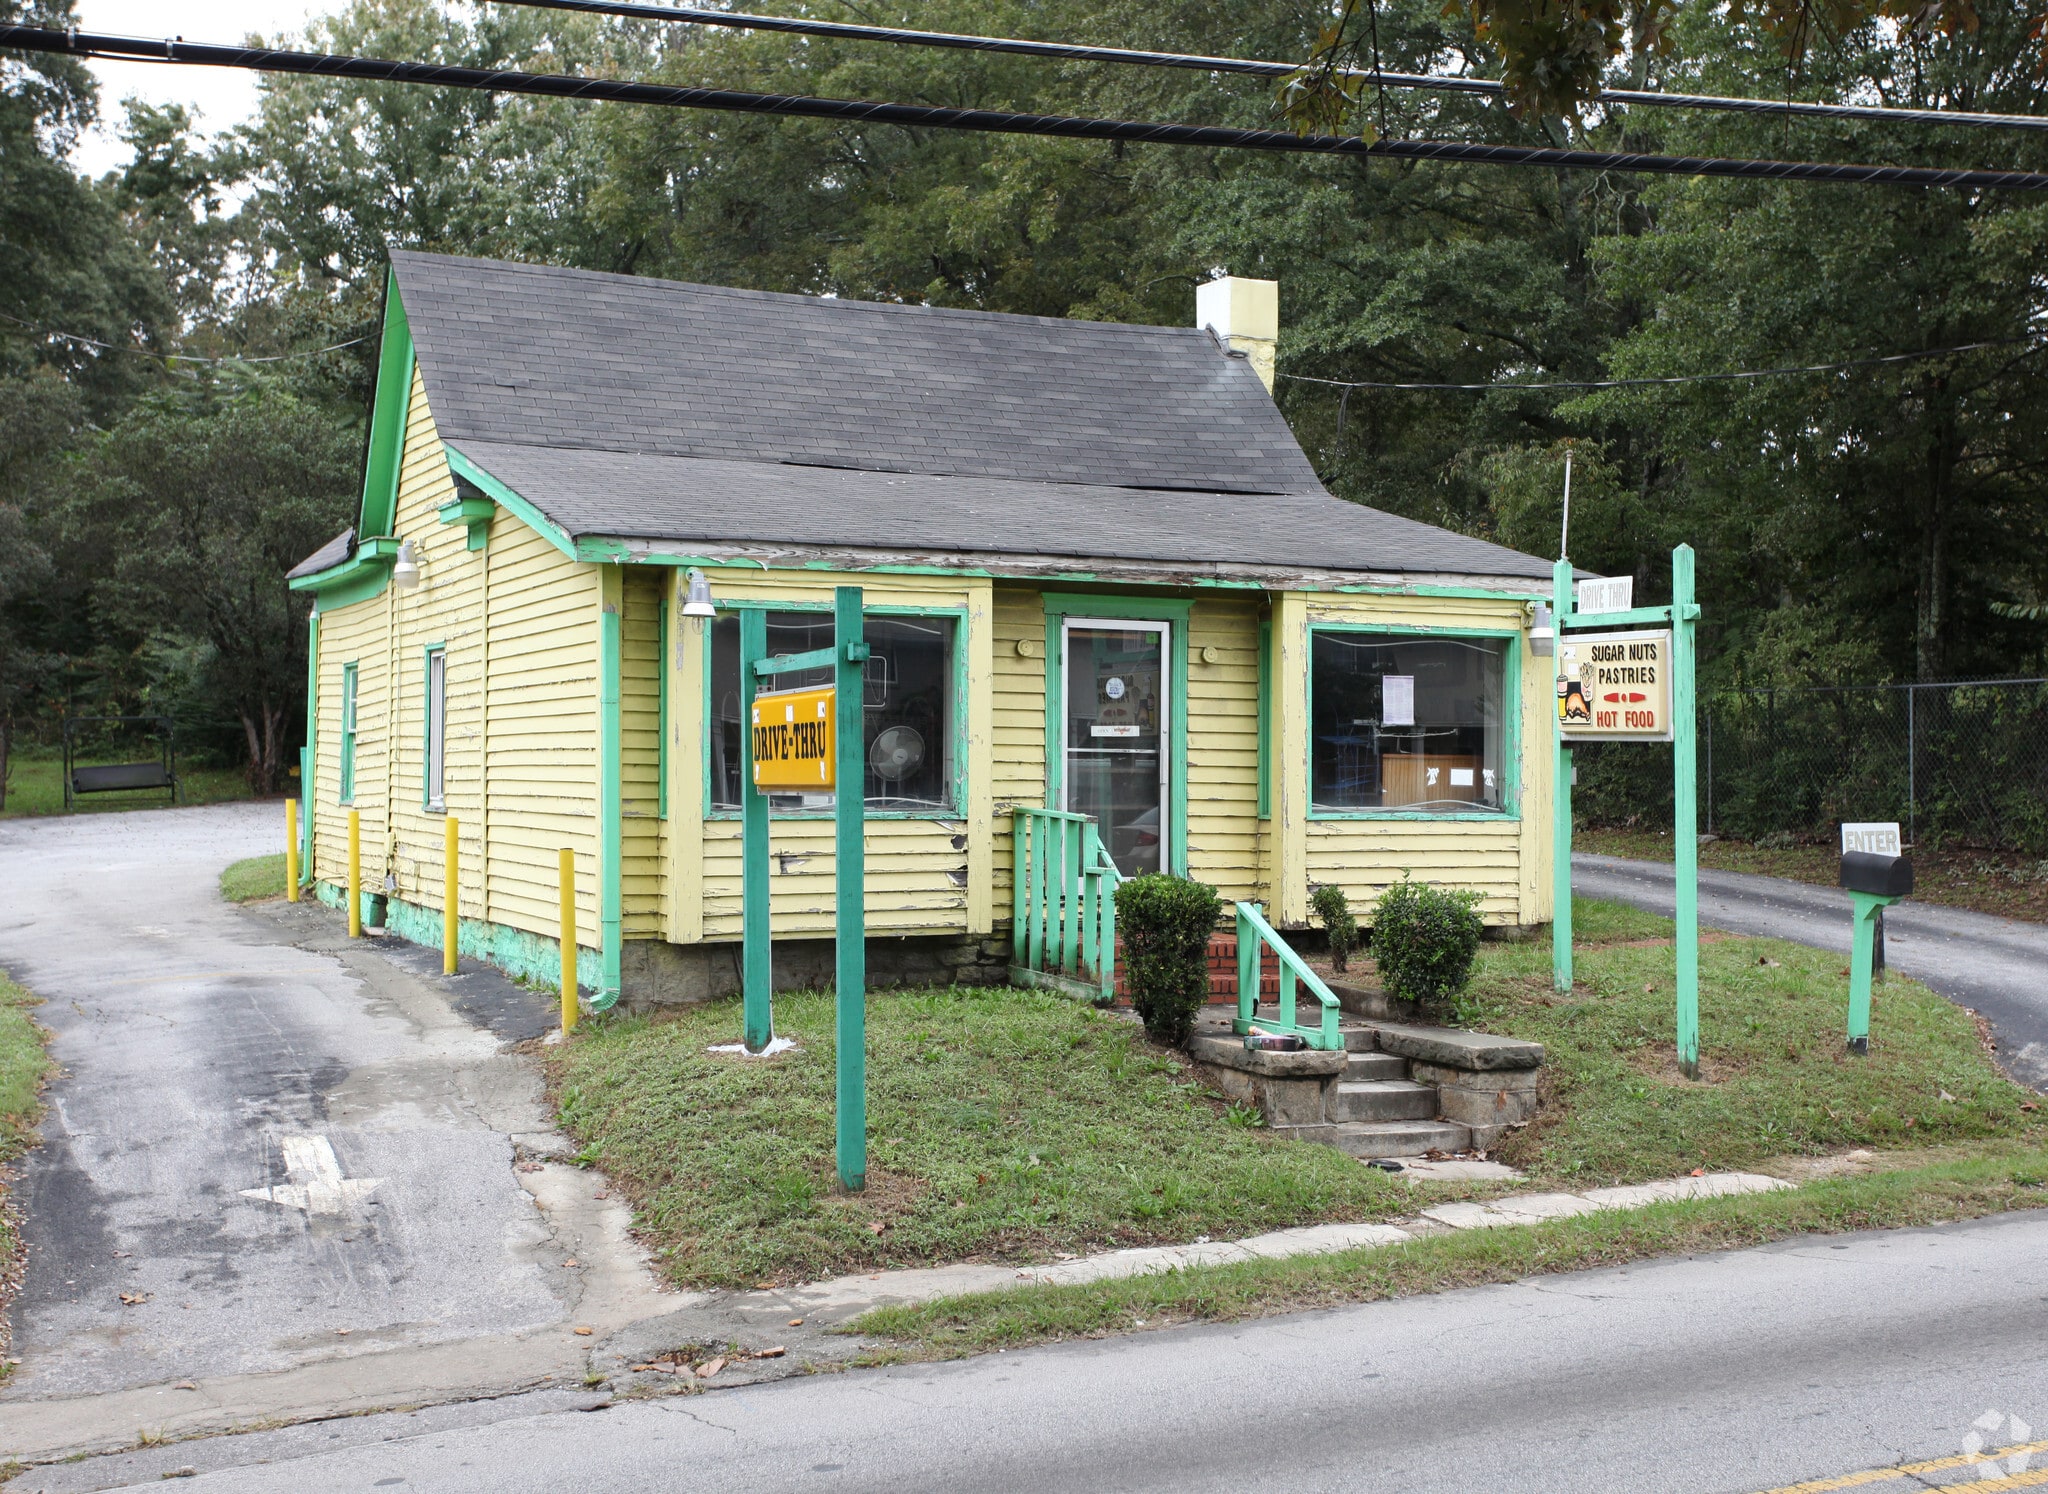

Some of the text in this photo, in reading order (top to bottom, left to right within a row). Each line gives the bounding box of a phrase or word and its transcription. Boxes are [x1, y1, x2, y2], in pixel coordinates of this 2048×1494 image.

[1580, 582, 1630, 609] DRIVE THRU
[1591, 643, 1657, 662] SUGAR NUTS
[1599, 666, 1655, 684] PASTRIES
[1596, 710, 1654, 728] HOT FOOD
[753, 721, 826, 762] DRIVE-THRU
[1845, 830, 1898, 853] ENTER
